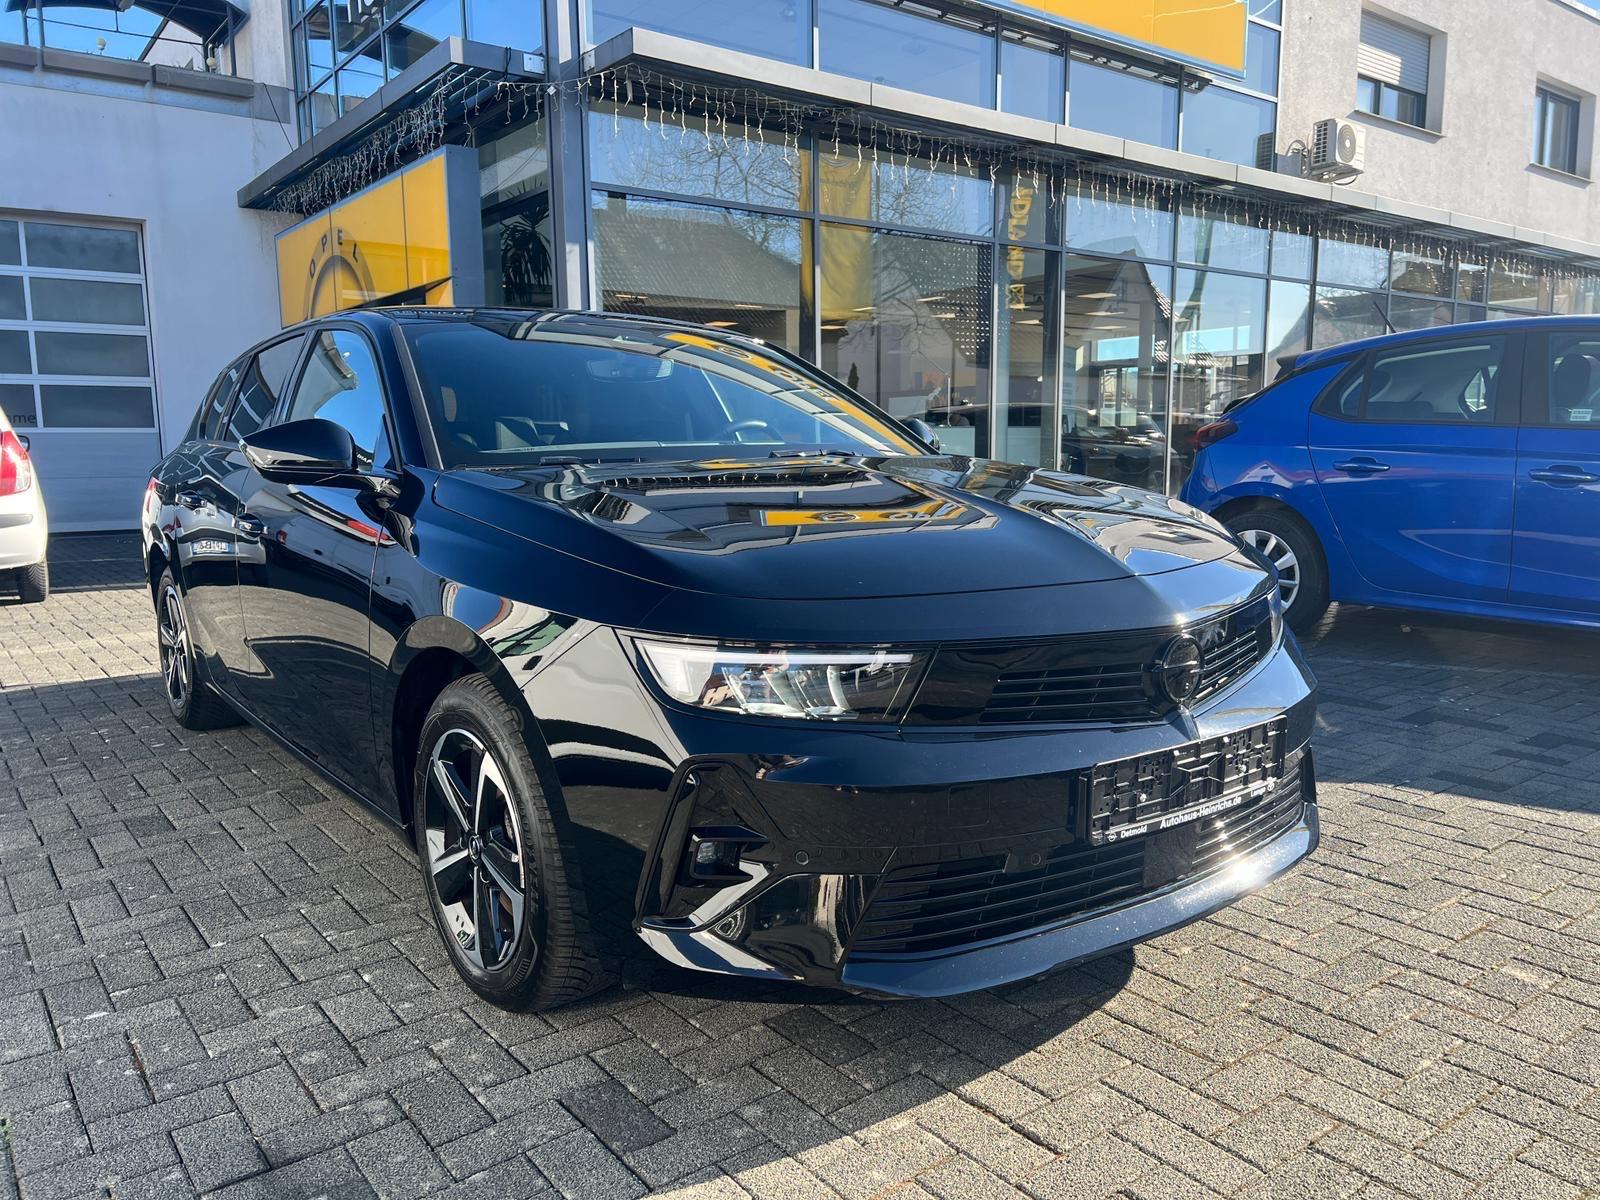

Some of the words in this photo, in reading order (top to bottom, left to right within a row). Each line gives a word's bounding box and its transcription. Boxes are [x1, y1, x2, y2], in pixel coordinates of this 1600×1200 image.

[309, 228, 359, 280] OPEL
[1120, 825, 1148, 839] Detmold
[1160, 796, 1242, 829] Autohaus-Heinrichs.de
